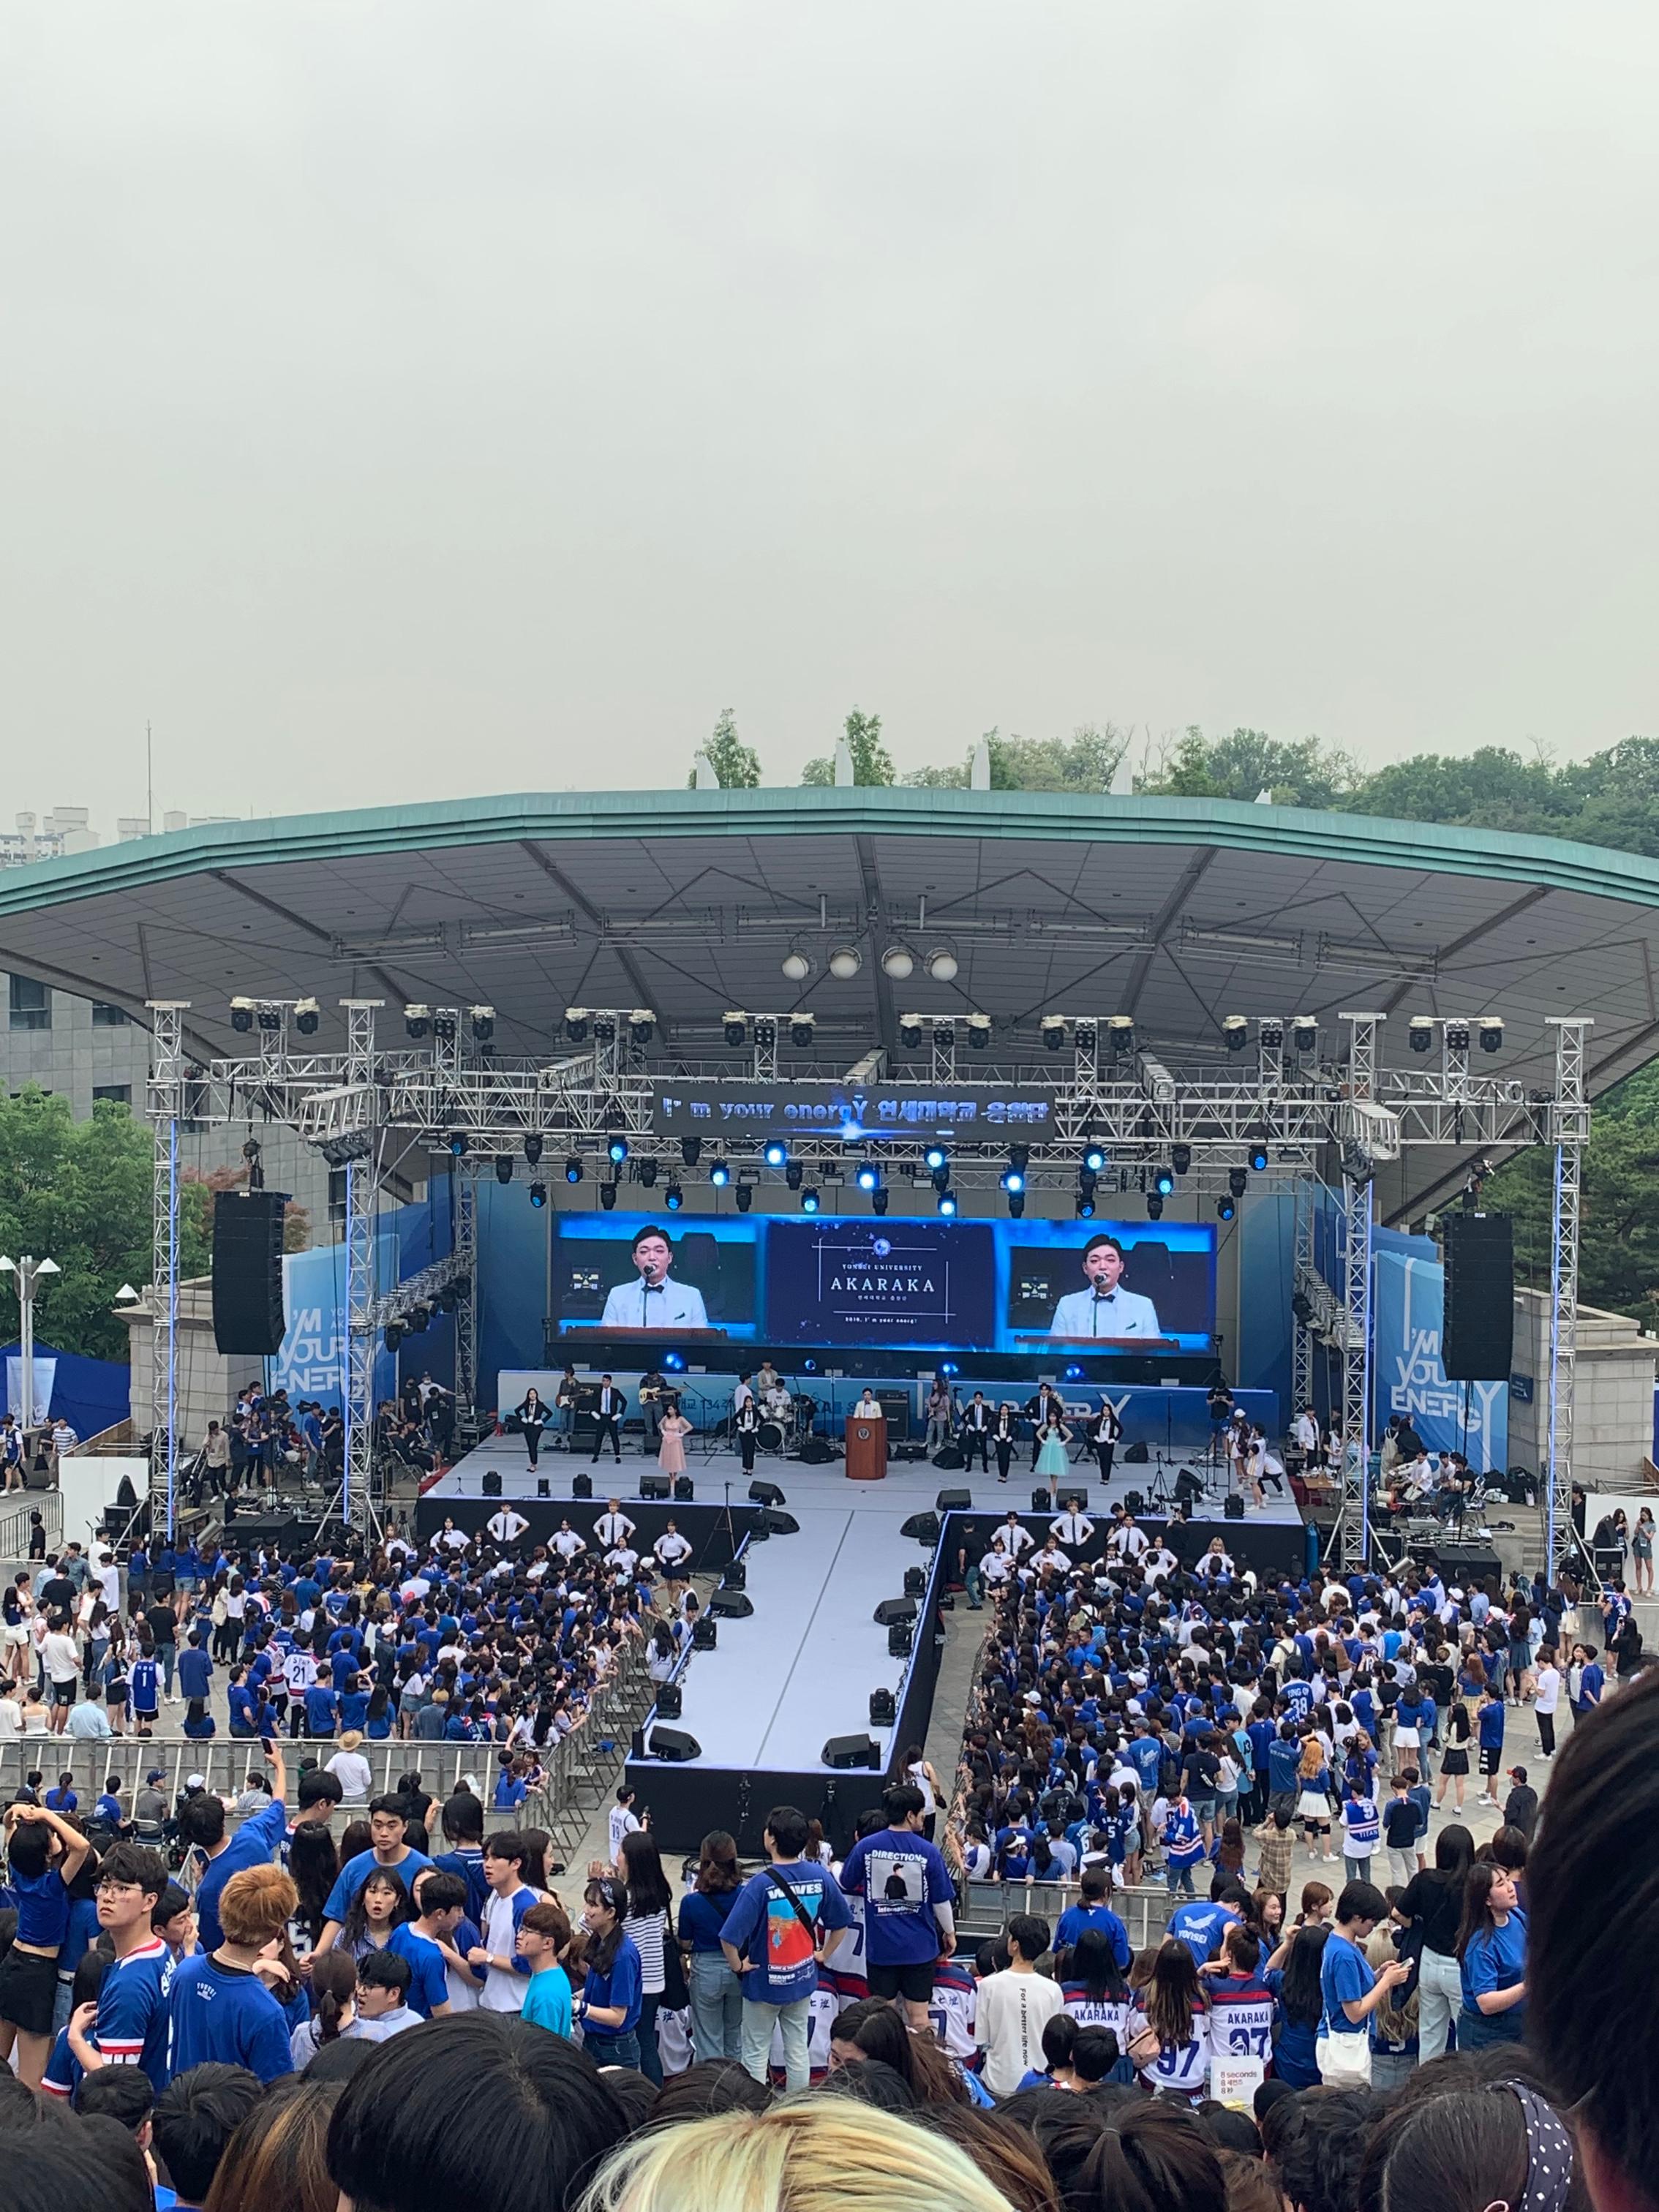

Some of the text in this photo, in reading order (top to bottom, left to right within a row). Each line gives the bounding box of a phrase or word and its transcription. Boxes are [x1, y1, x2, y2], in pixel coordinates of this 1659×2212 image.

[719, 1103, 775, 1119] your
[877, 1100, 1049, 1123] 연세대학교 응원단
[830, 1277, 935, 1292] AKARAKA
[1403, 1257, 1439, 1355] I'M
[142, 1672, 147, 1688] 1
[293, 1666, 306, 1683] 21
[1290, 1697, 1308, 1715] 38
[1363, 1805, 1374, 1820] 9
[612, 1824, 620, 1840] 19
[1107, 1826, 1116, 1839] 5
[847, 1921, 865, 1957] 7
[928, 1995, 959, 2006] 七班
[1074, 2009, 1119, 2022] AKARAKA
[928, 2009, 947, 2047] 7
[1156, 2038, 1200, 2077] 97
[1227, 2070, 1257, 2078] seconds
